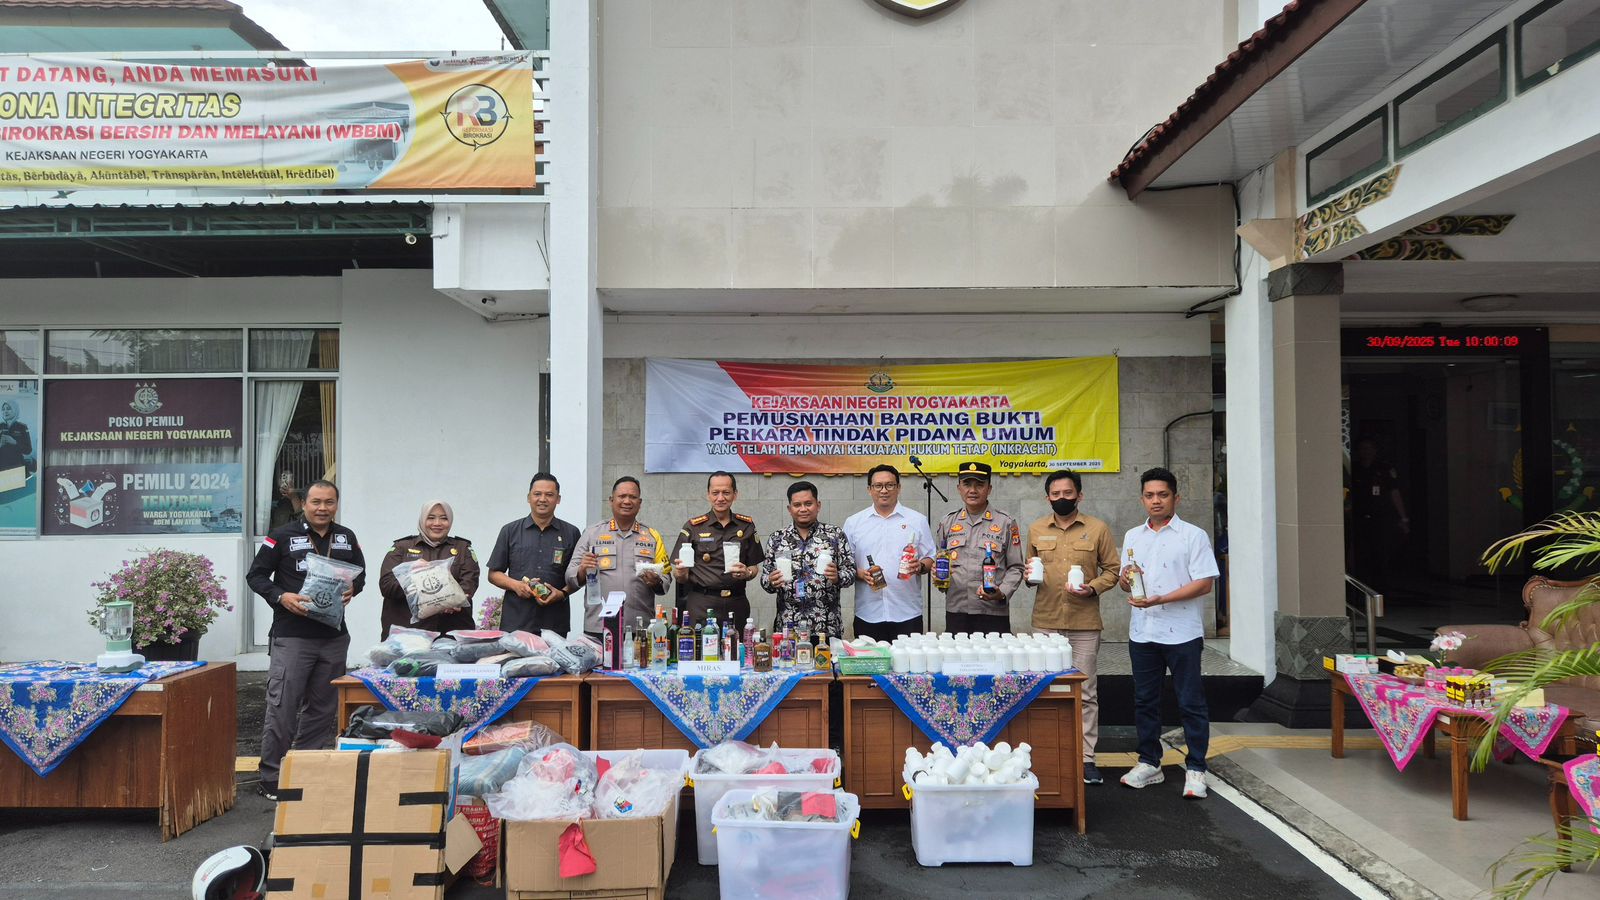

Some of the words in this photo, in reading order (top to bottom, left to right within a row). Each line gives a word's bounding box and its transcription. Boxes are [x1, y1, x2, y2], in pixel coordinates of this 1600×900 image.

[17, 66, 115, 86] DATANG,
[122, 66, 184, 82] ANDA
[191, 66, 318, 82] MEMASUKI
[66, 92, 241, 119] INTEGRITAS
[0, 125, 94, 141] IROKRASI
[101, 125, 171, 140] BERSIH
[177, 125, 220, 140] DAN
[224, 124, 321, 140] MELAYANI
[326, 123, 401, 141] (WBBM)
[5, 150, 77, 161] KEJAKSAAN
[80, 150, 125, 161] NEGERI
[129, 150, 208, 160] YOGYAKARTA
[1366, 336, 1435, 348] 30/09/2025
[1439, 336, 1461, 347] Tue
[751, 396, 842, 410] KEJAKSAAN
[847, 396, 903, 410] NEGERI
[906, 395, 1011, 409] YOGYAKARTA
[108, 416, 143, 427] POSKO
[145, 415, 184, 427] PEMILU
[723, 412, 877, 426] PEMUSNAHAN
[880, 412, 969, 426] BARANG
[976, 411, 1040, 425] BUKTI
[60, 431, 123, 442] KEJAKSAAN
[125, 431, 164, 441] NEGERI
[166, 429, 232, 440] YOGYAKARTA
[709, 427, 808, 442] PERKARA
[812, 427, 891, 442] TINDAK
[896, 427, 976, 441] PIDANA
[982, 427, 1054, 441] UMUM
[706, 443, 738, 455] YANG
[741, 443, 776, 455] TELAH
[779, 443, 845, 455] MEMPUNYAI
[847, 443, 906, 455] KEKUATAN
[910, 443, 950, 455] HUKUM
[953, 443, 989, 455] TETAP
[991, 443, 1057, 456] (INKRACHT)
[999, 459, 1048, 469] Yogyakarta,
[123, 473, 186, 490] PEMILU
[190, 473, 230, 489] 2024
[141, 494, 213, 511] TENTREM
[170, 510, 211, 518] YOGYAKARTA
